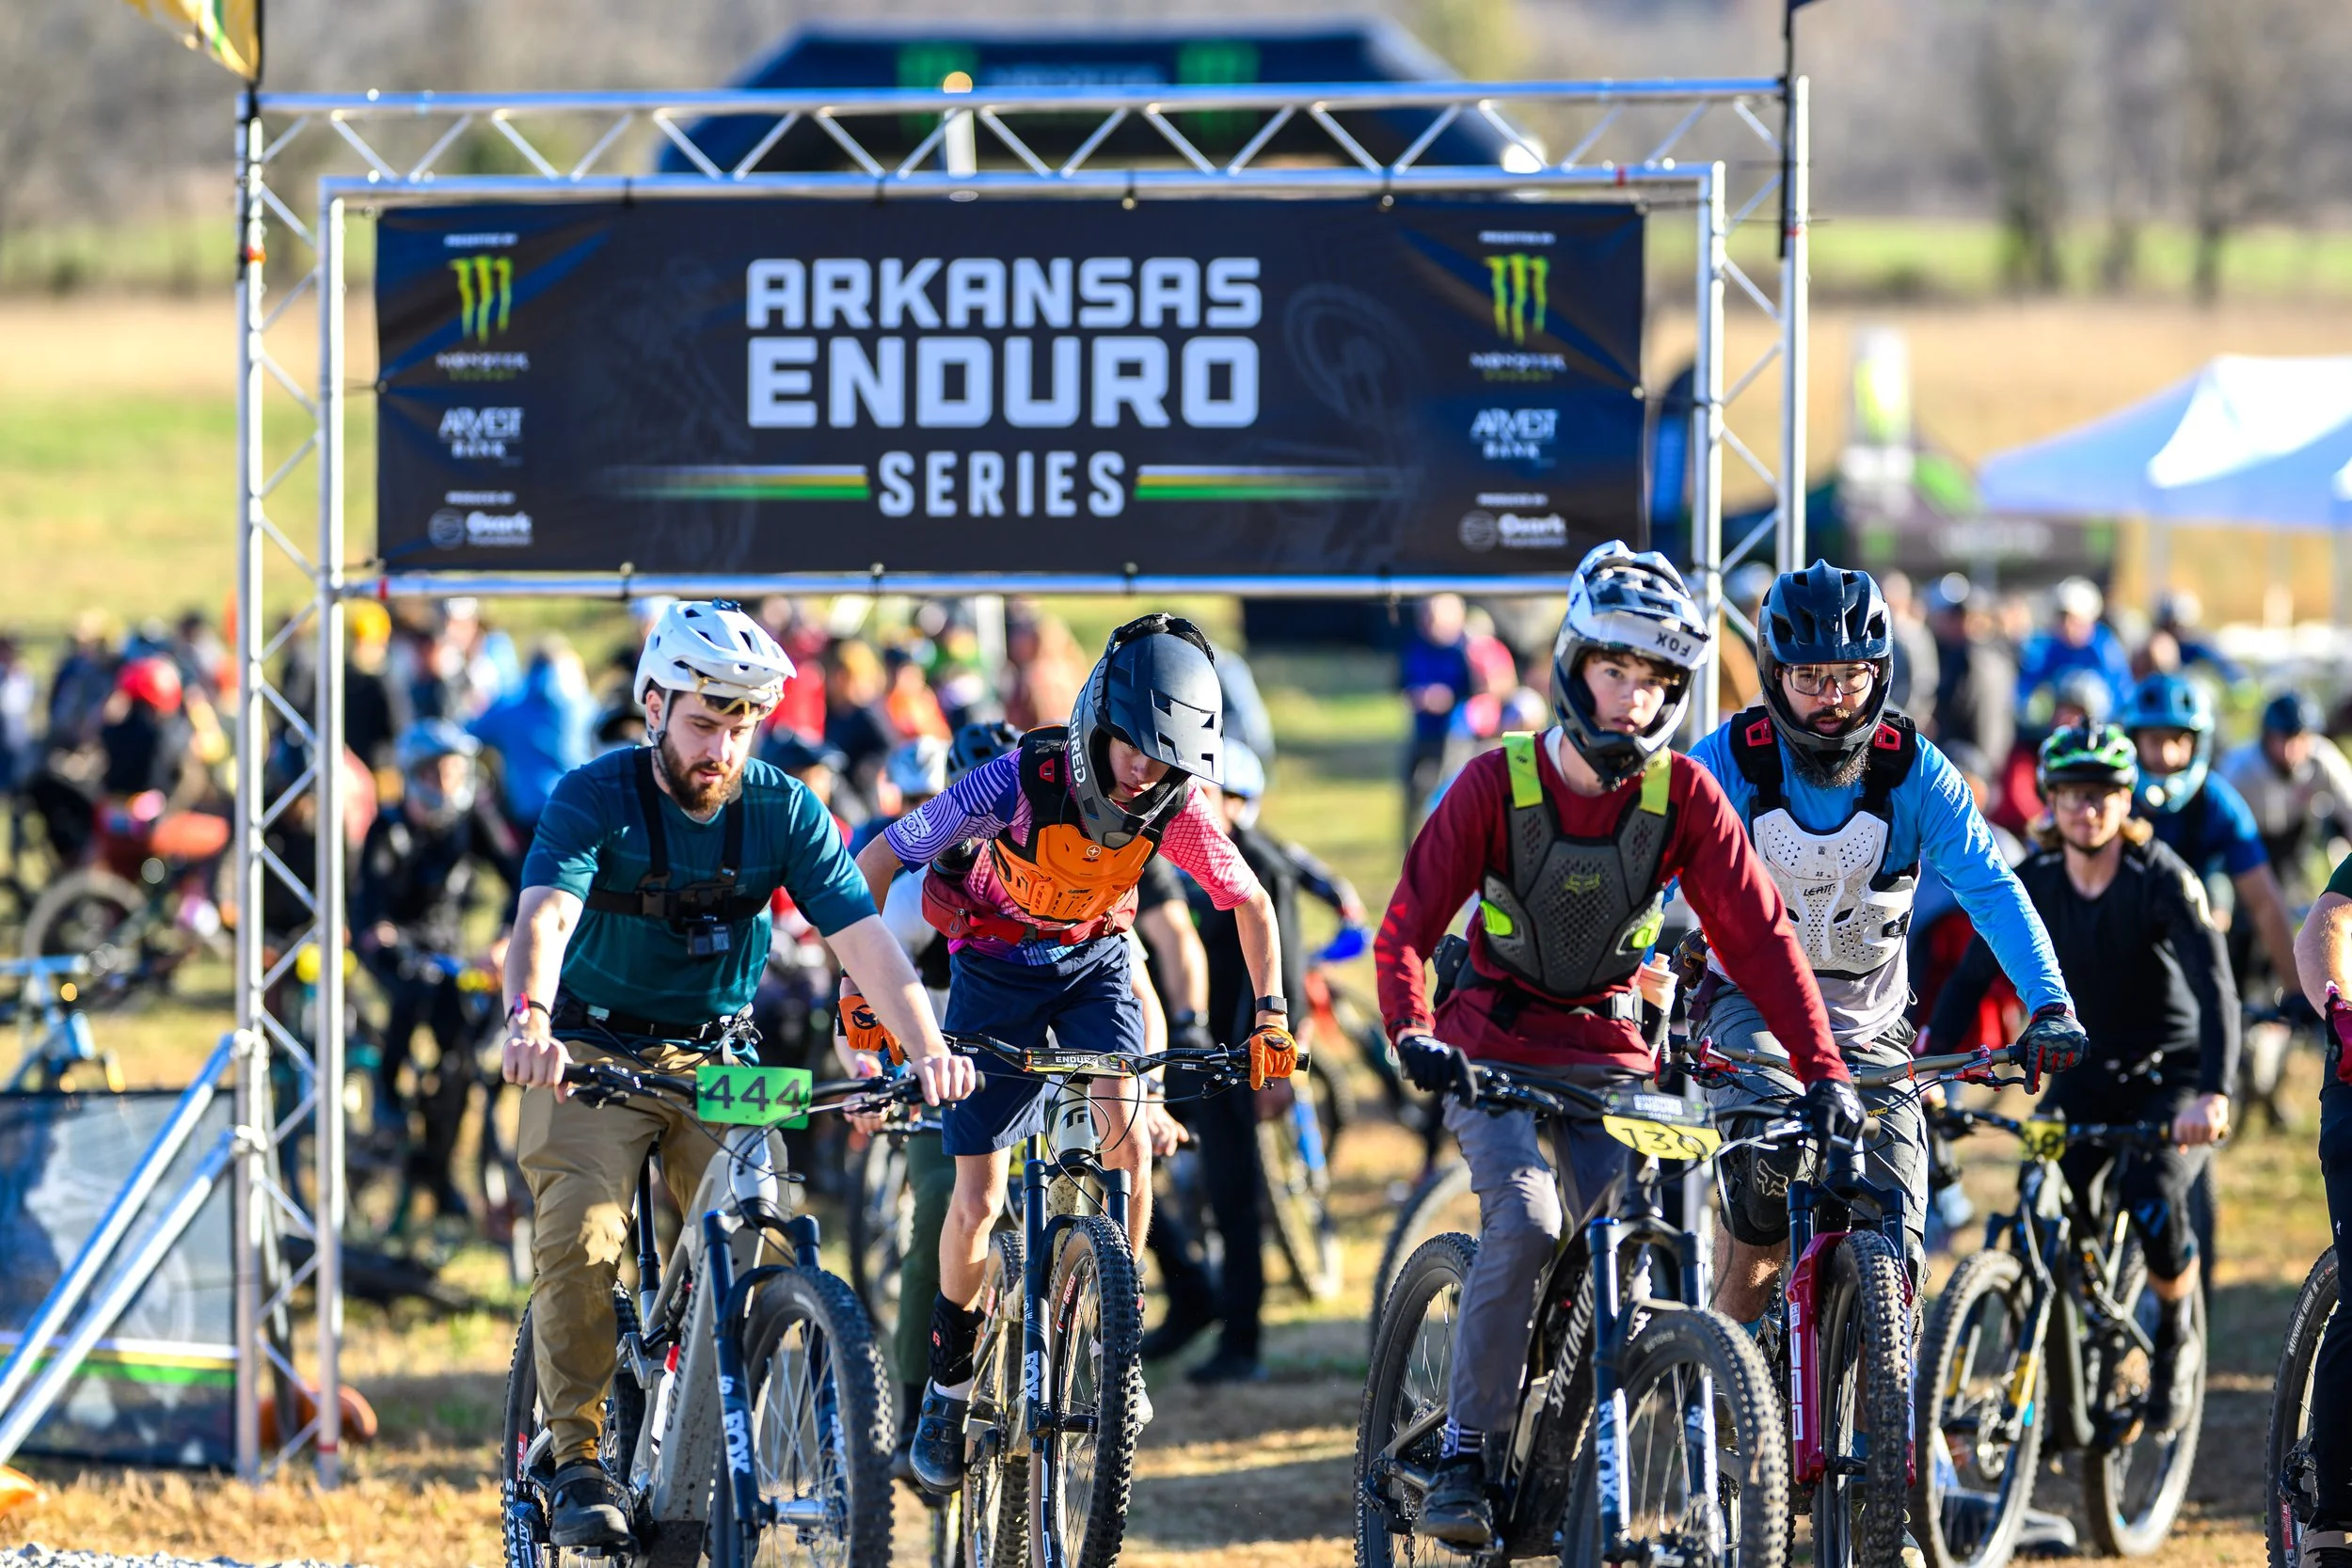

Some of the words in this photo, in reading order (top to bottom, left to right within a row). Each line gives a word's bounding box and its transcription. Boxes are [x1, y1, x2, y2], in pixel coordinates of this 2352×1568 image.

[746, 257, 1263, 329] ARKANSAS
[747, 336, 1260, 428] ENDURO
[878, 451, 1125, 517] SERIES
[1656, 631, 1692, 657] FOX
[705, 1074, 806, 1114] 444
[1025, 1350, 1040, 1401] FOX
[723, 1409, 751, 1474] FOX
